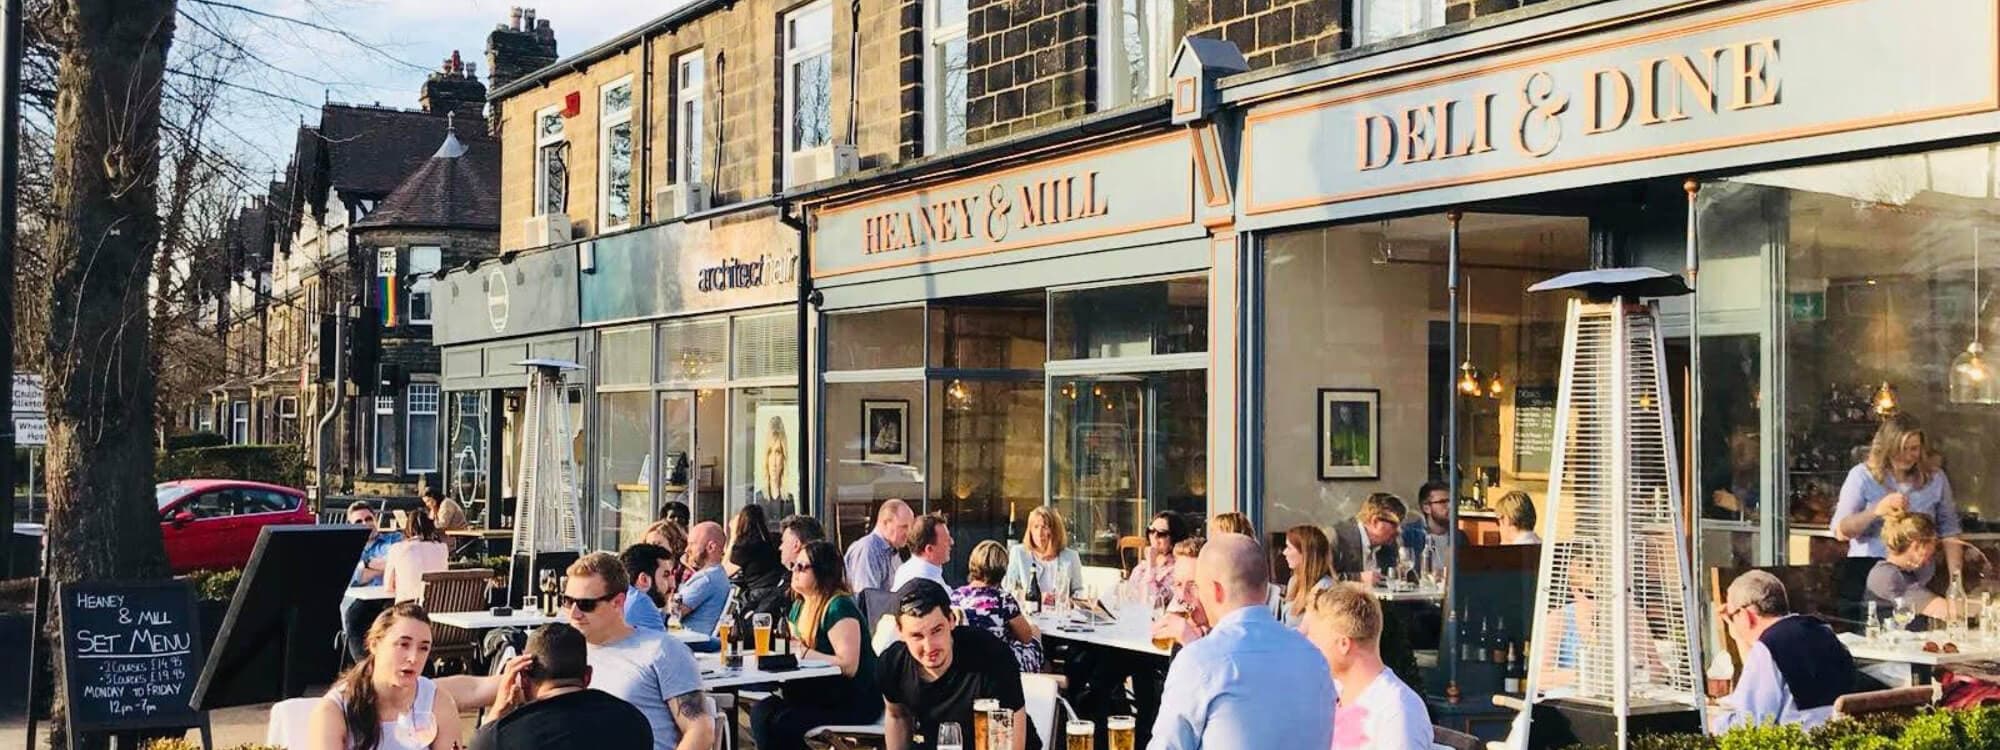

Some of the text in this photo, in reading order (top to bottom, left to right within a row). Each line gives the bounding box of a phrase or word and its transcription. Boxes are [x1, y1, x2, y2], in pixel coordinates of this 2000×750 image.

[1356, 39, 1782, 172] DELI & DINE
[862, 171, 1108, 255] HEANEY & MILL
[77, 629, 191, 653] SET MENU
[118, 607, 132, 624] &
